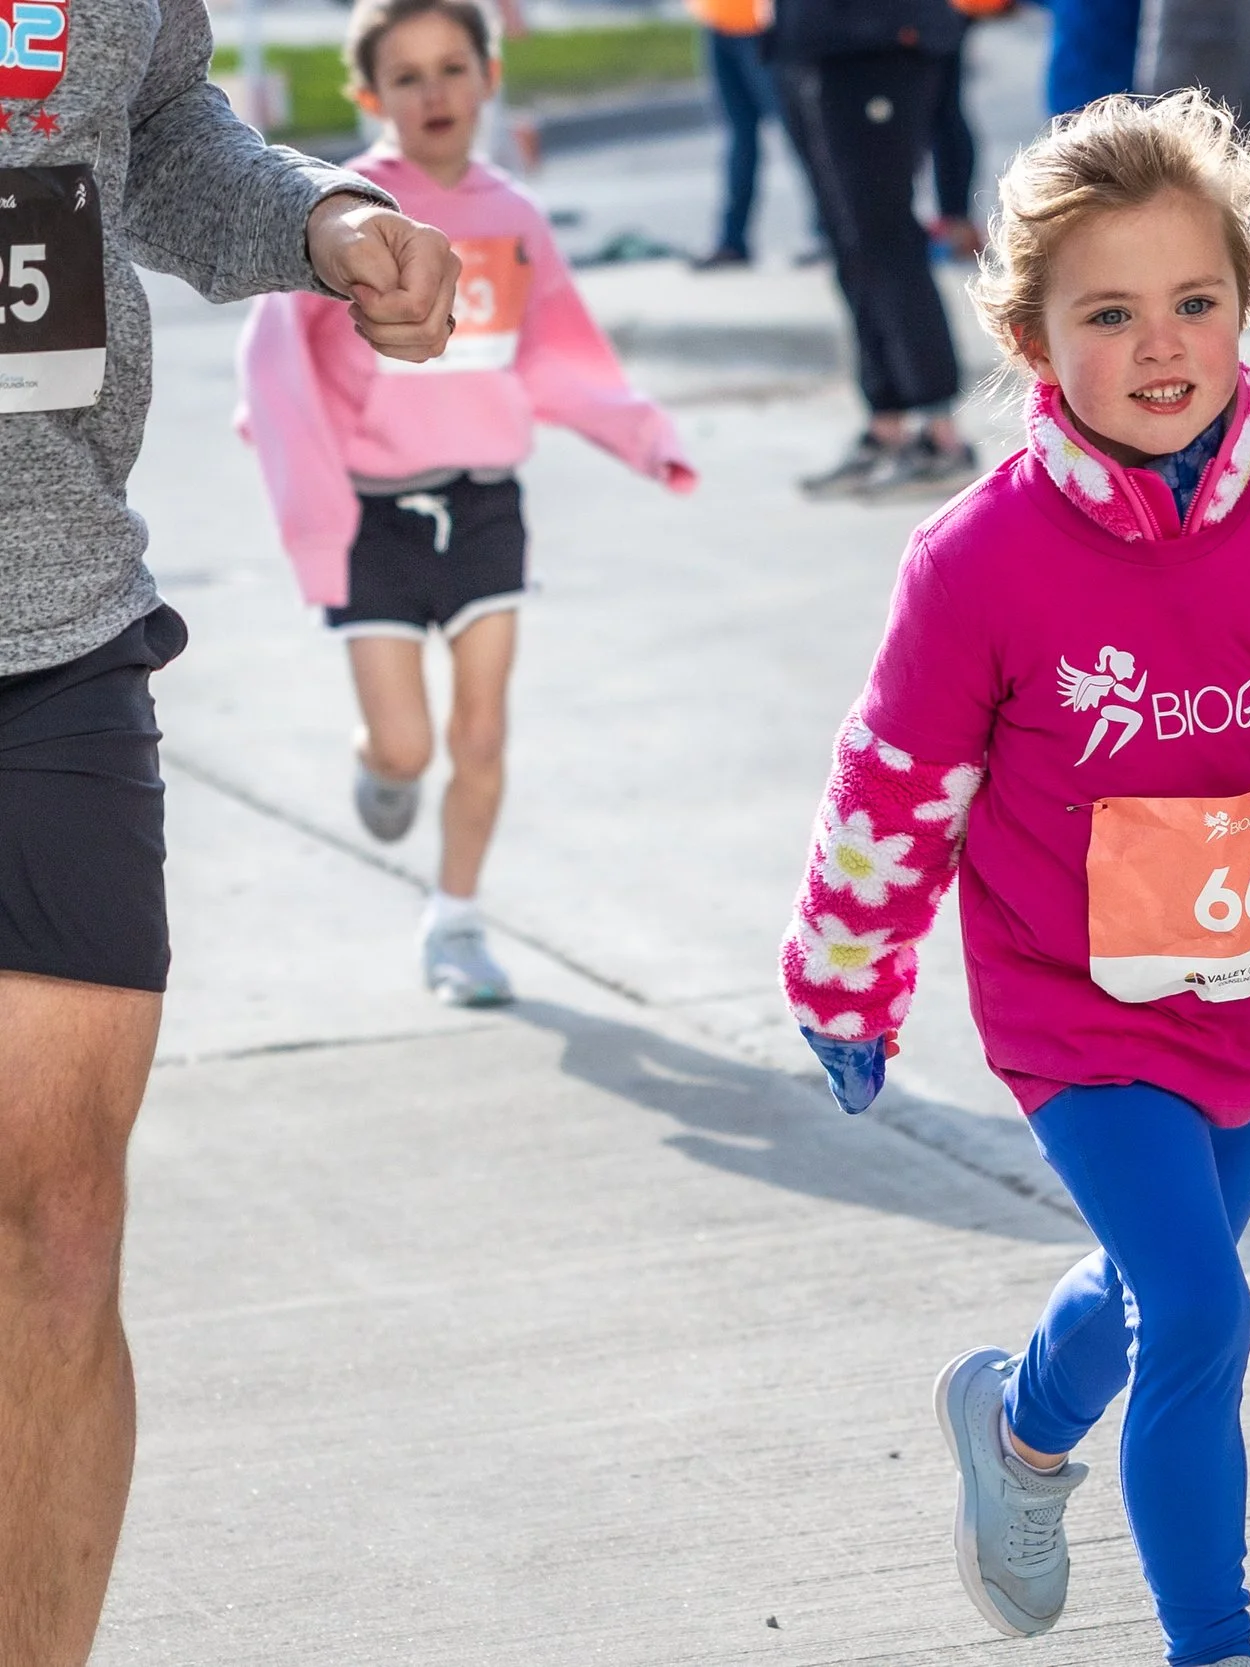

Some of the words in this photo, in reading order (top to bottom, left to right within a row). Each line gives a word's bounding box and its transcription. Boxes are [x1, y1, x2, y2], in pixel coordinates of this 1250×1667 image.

[0, 2, 65, 72] .2
[0, 243, 50, 324] 5
[1208, 968, 1247, 983] VALLEY
